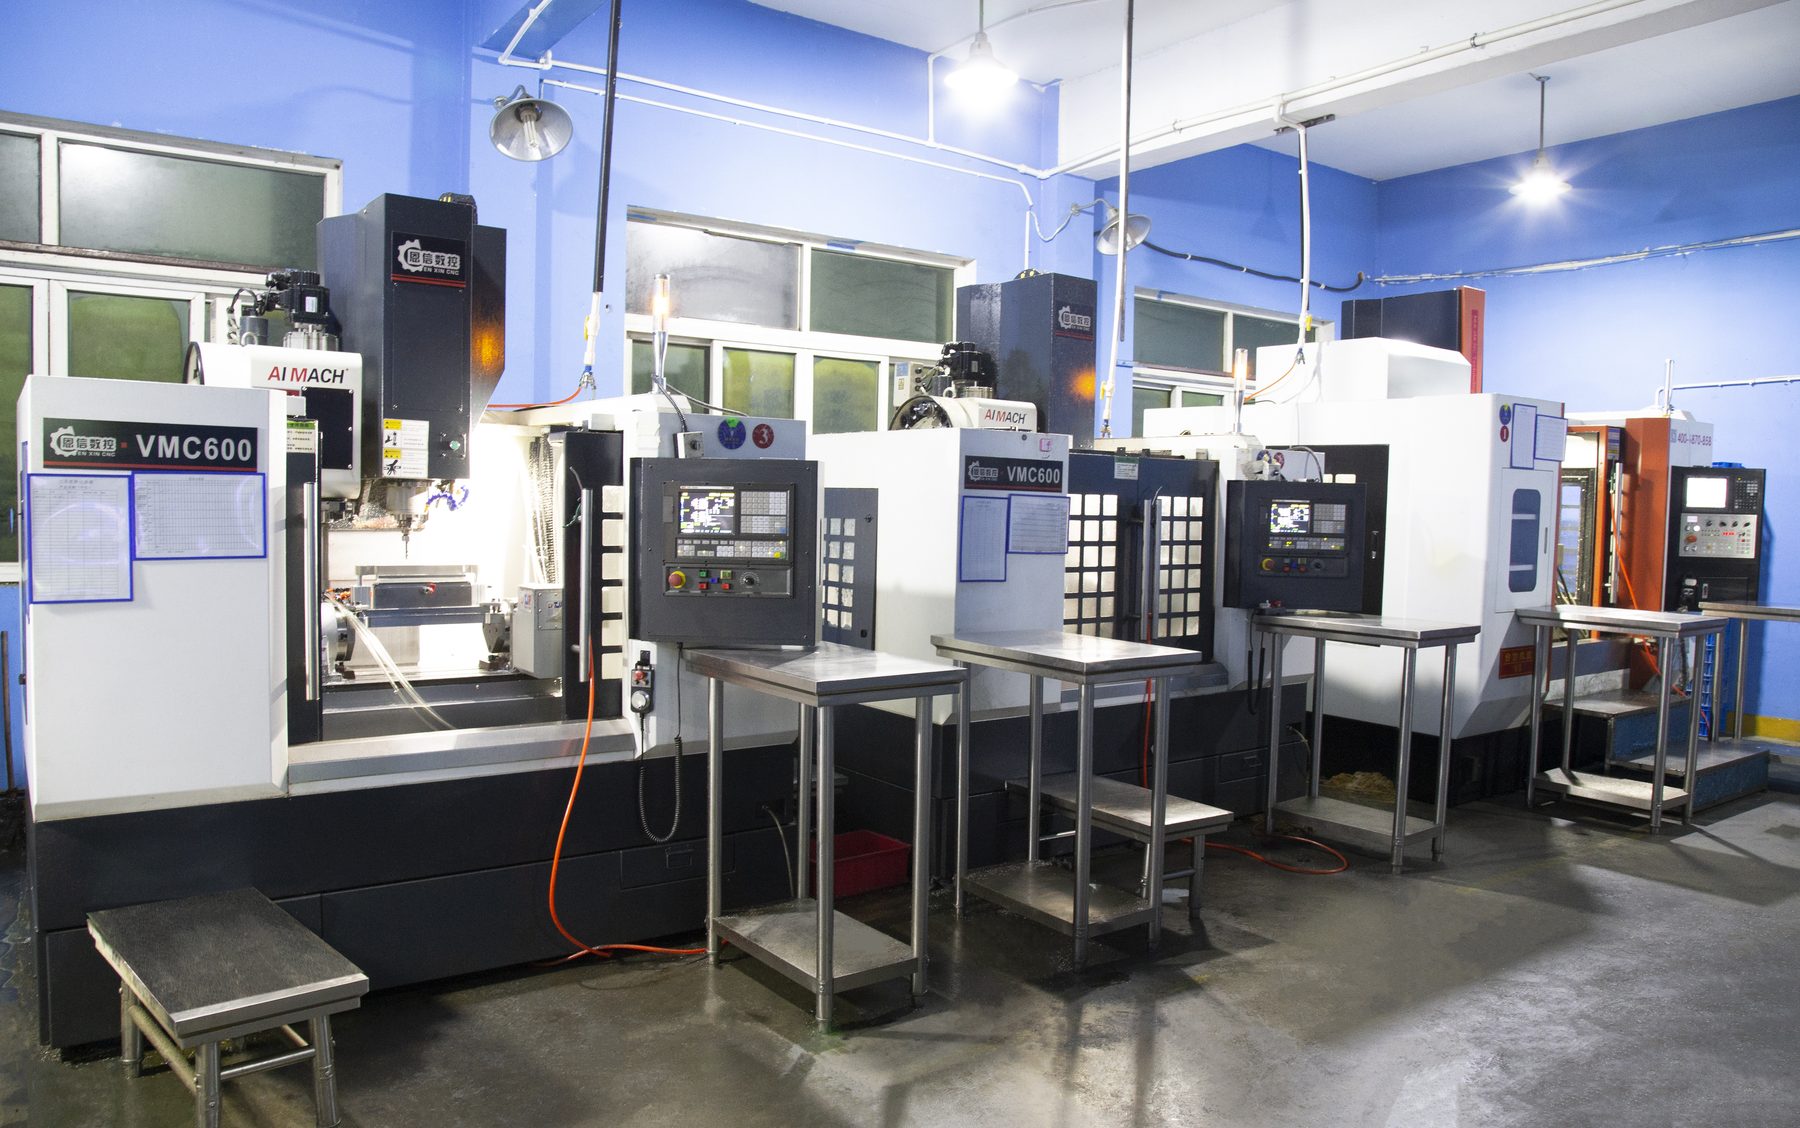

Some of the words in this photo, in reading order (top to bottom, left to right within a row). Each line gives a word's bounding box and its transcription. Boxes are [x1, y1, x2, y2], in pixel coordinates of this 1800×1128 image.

[409, 250, 458, 268] 恩信数控
[62, 435, 115, 451] 恩信数控
[758, 429, 769, 444] 3
[135, 434, 252, 462] VMC600
[1007, 466, 1060, 484] VMC600
